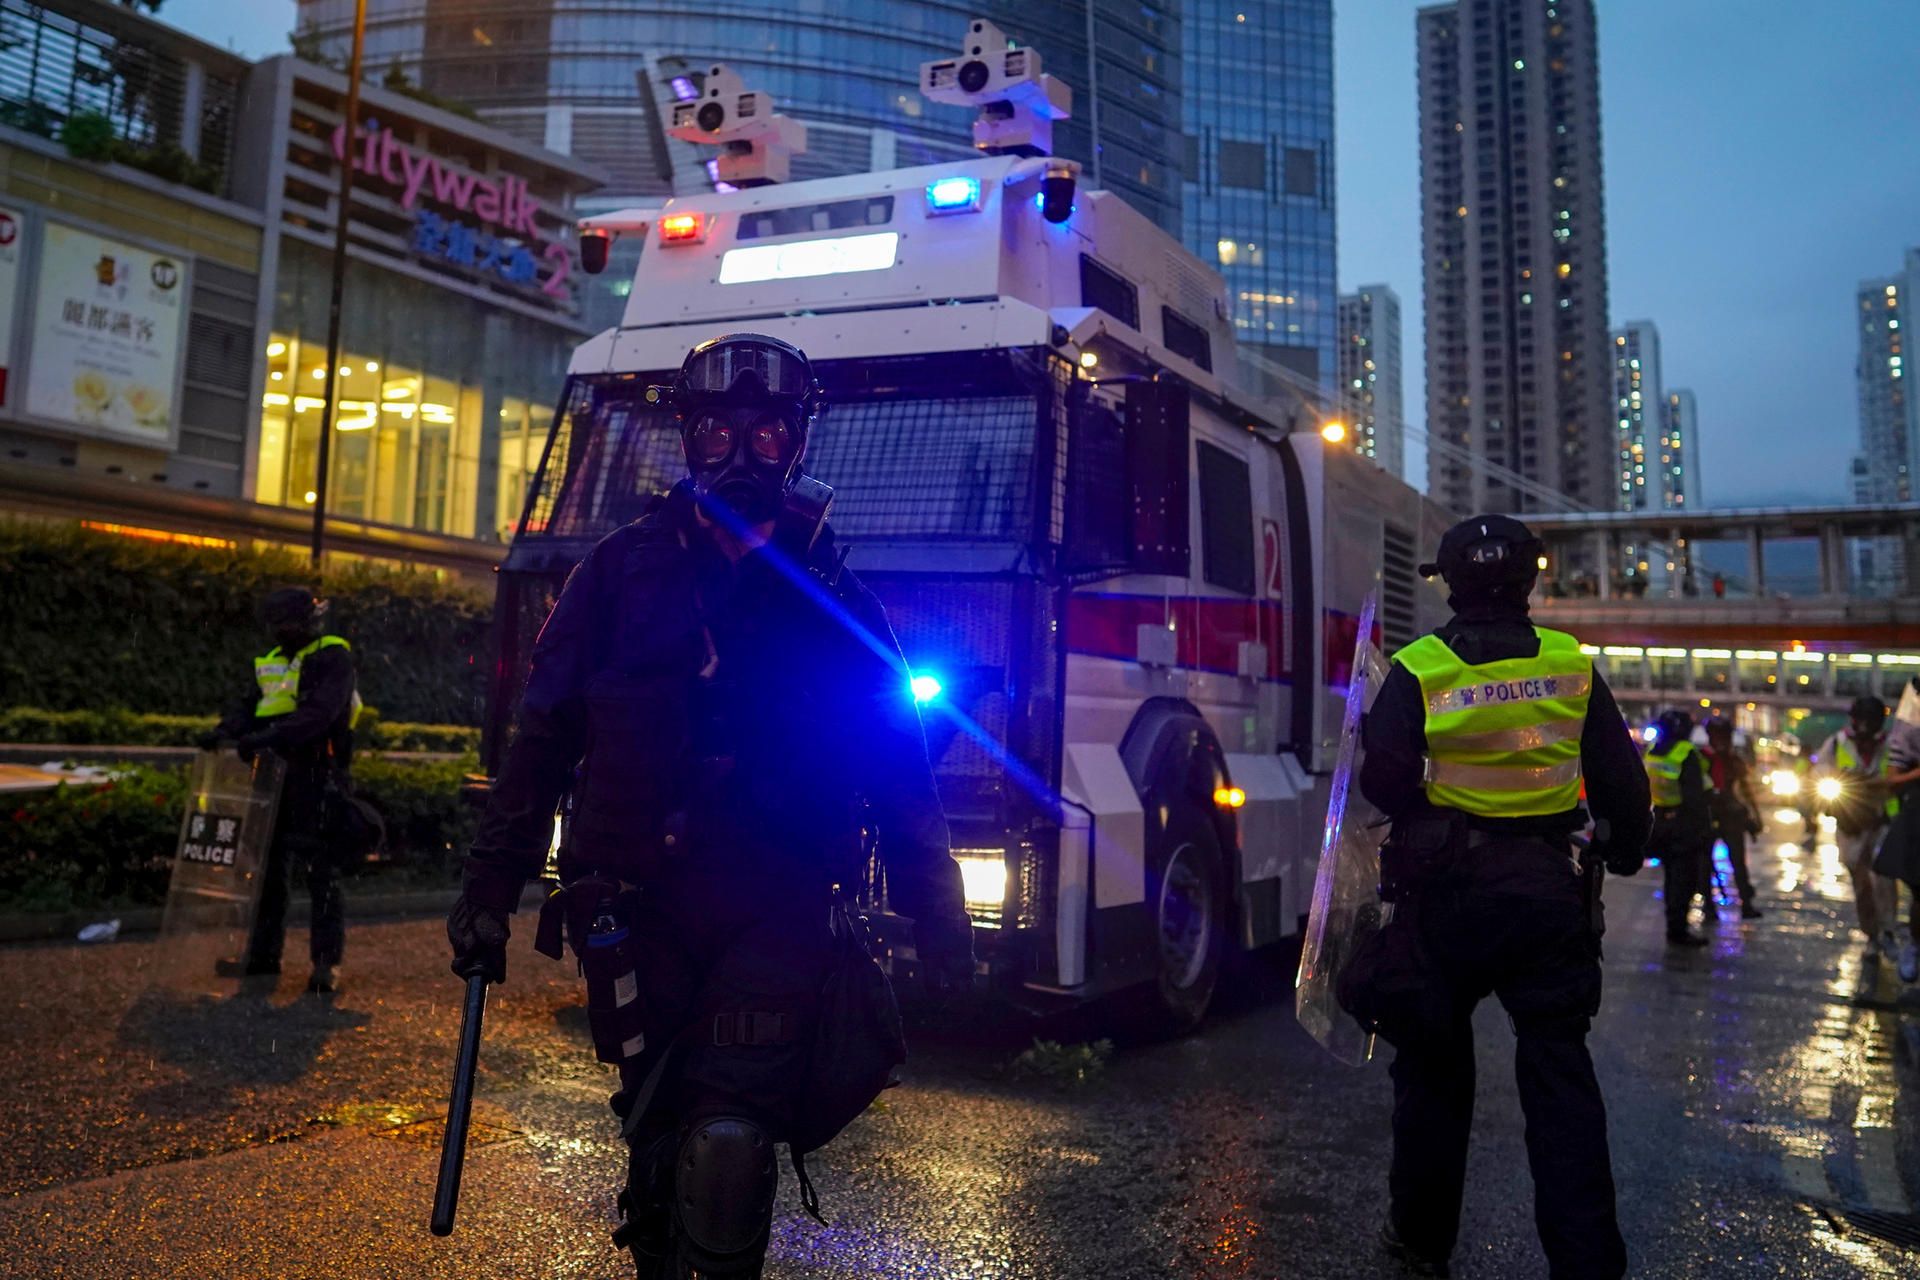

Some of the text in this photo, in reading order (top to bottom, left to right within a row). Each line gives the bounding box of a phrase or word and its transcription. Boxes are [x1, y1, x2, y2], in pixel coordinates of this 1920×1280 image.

[542, 242, 572, 299] 2
[1264, 521, 1281, 599] 2
[1484, 680, 1542, 702] POLICE
[183, 842, 236, 865] POLICE
